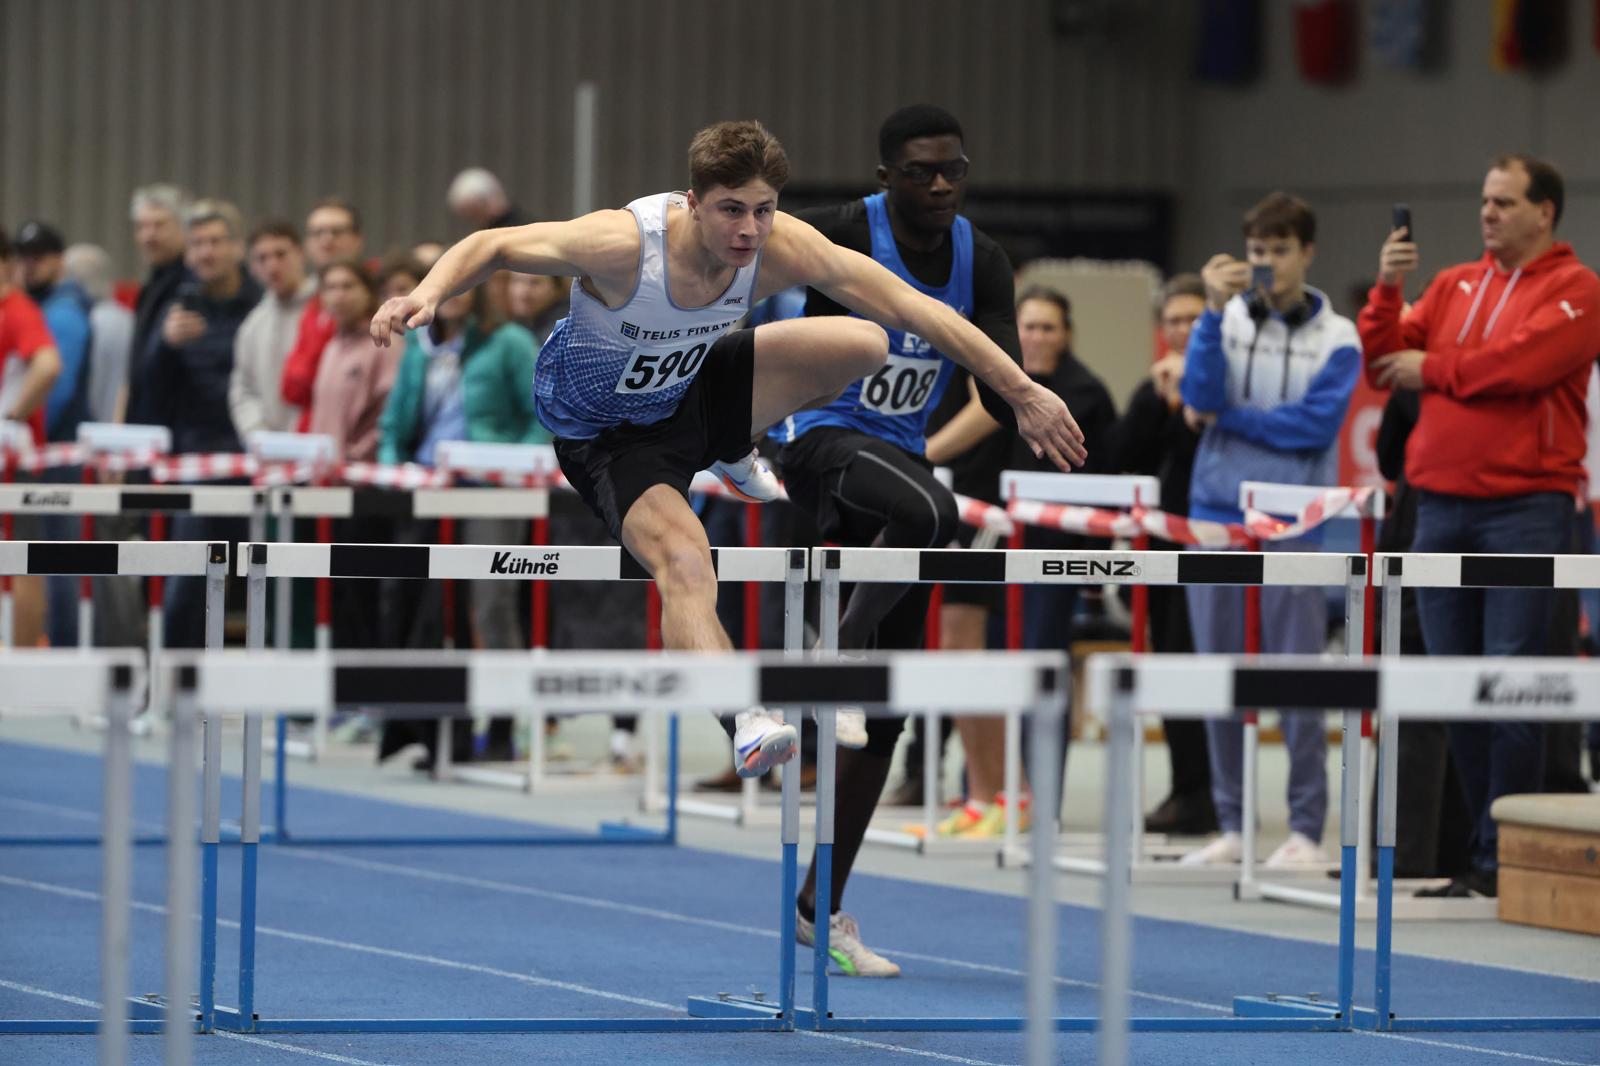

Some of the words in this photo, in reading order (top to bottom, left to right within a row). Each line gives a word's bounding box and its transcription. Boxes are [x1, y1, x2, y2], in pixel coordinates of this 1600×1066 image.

[641, 329, 681, 341] TELIS
[686, 319, 738, 338] FINAN
[624, 342, 708, 390] 590
[866, 364, 938, 411] 608
[489, 551, 559, 575] Kühne
[543, 551, 560, 561] ort
